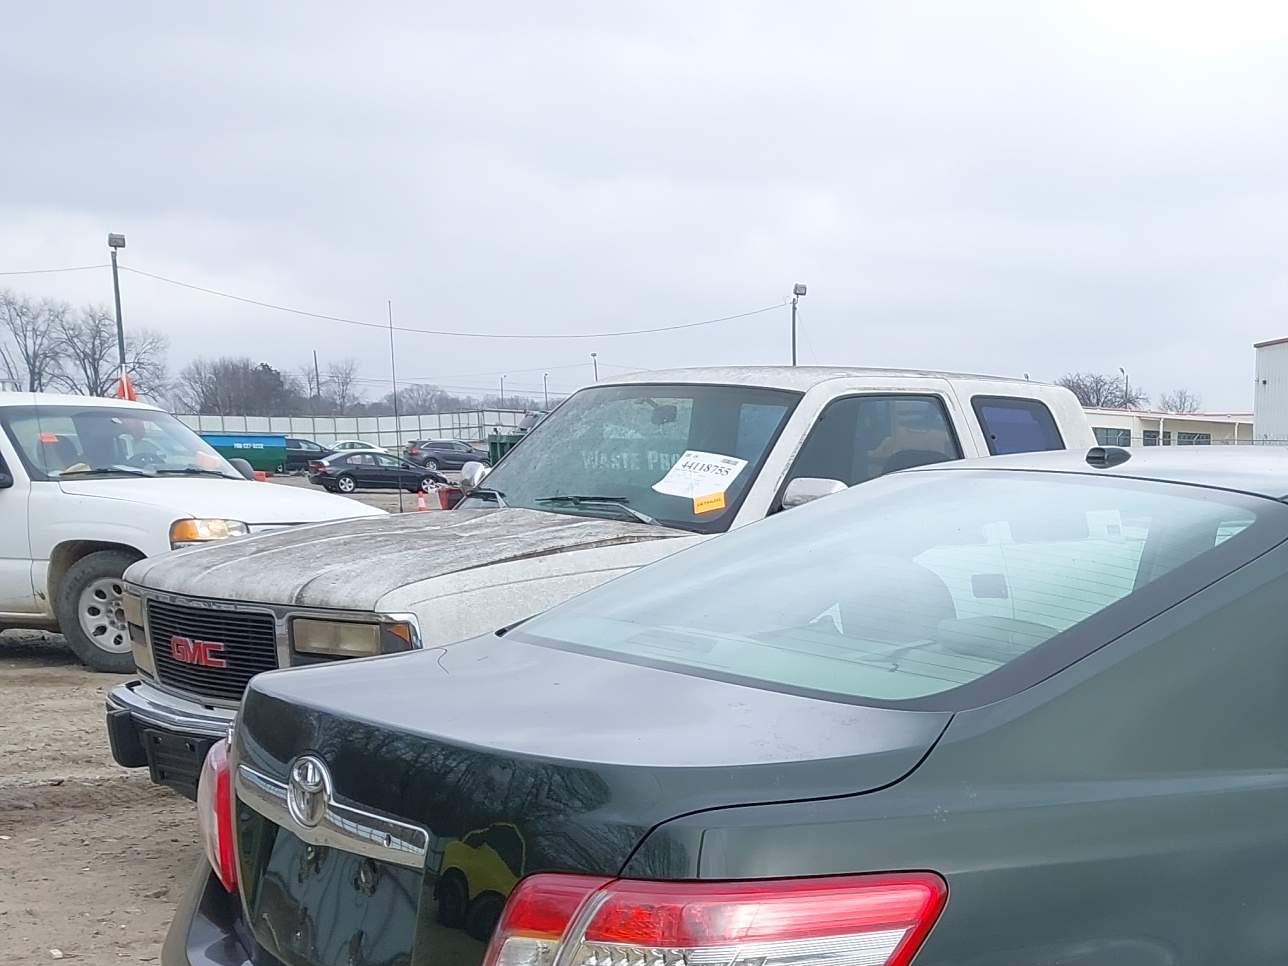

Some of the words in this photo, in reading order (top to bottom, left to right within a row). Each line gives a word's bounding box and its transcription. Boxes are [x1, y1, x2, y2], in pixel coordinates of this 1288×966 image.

[581, 450, 641, 471] WASTE
[681, 461, 733, 476] 44118755
[170, 635, 227, 668] GMC
